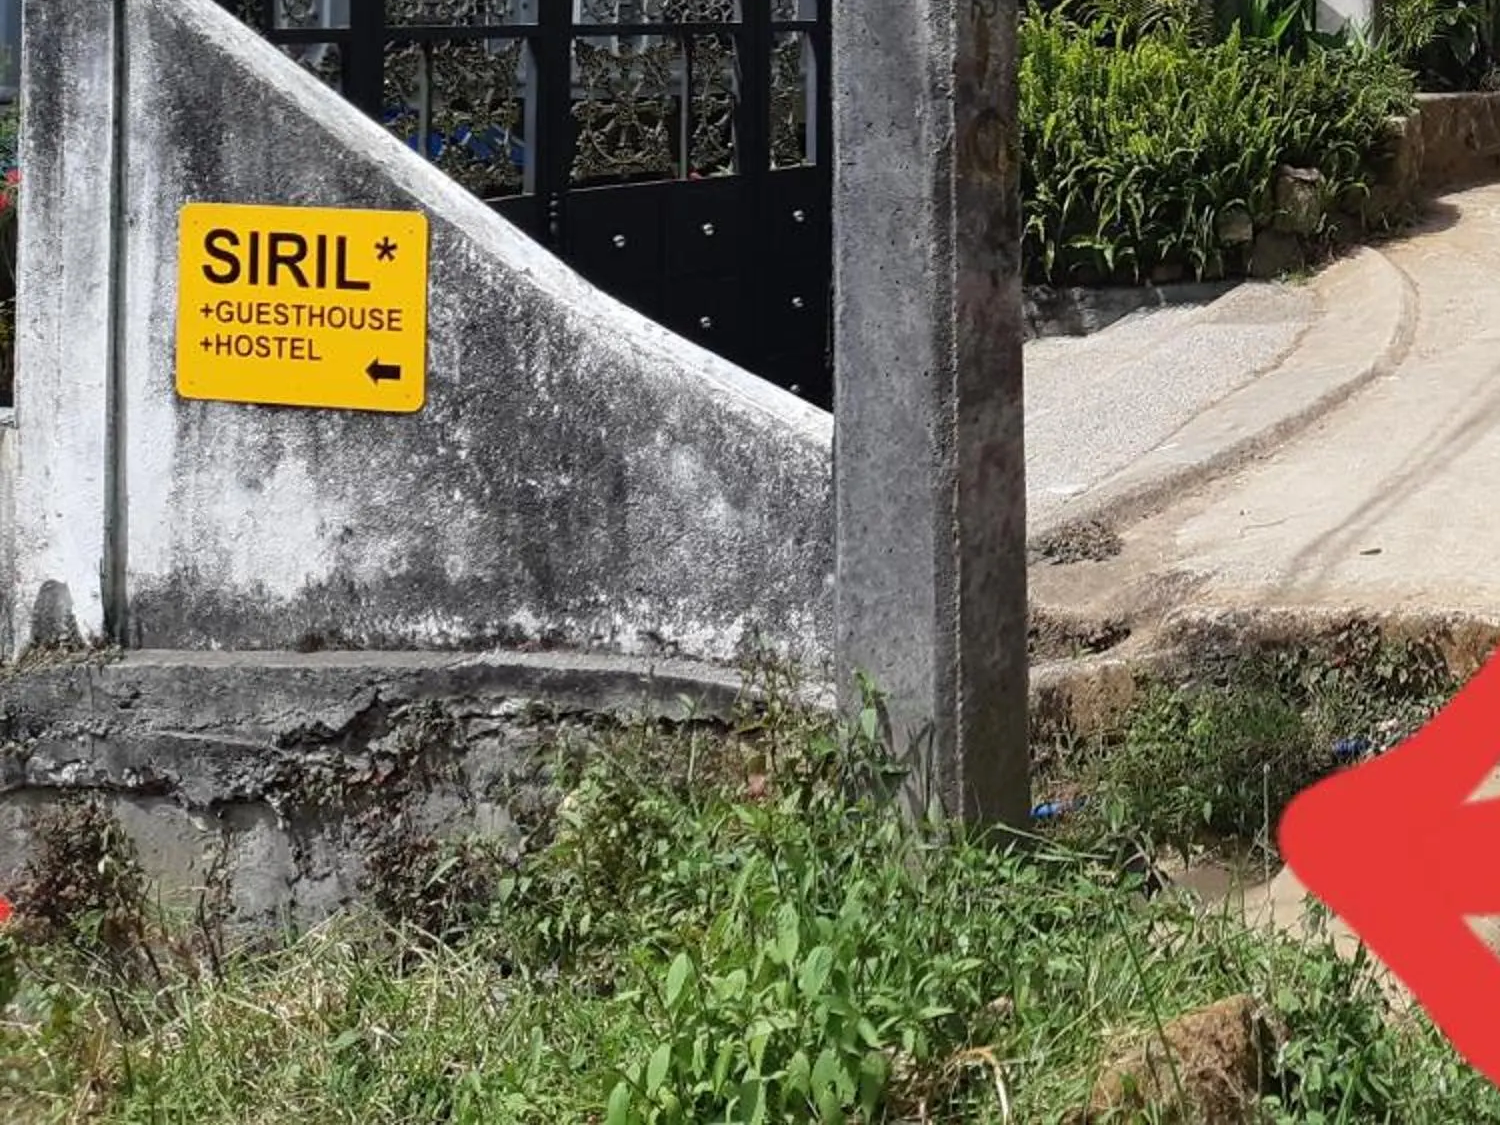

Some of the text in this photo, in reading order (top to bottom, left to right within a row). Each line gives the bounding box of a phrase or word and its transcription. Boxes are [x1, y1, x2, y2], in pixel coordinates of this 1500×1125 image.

[201, 228, 371, 291] SIRIL
[199, 300, 404, 332] +GUESTHOUSE
[199, 334, 323, 362] +HOSTEL
